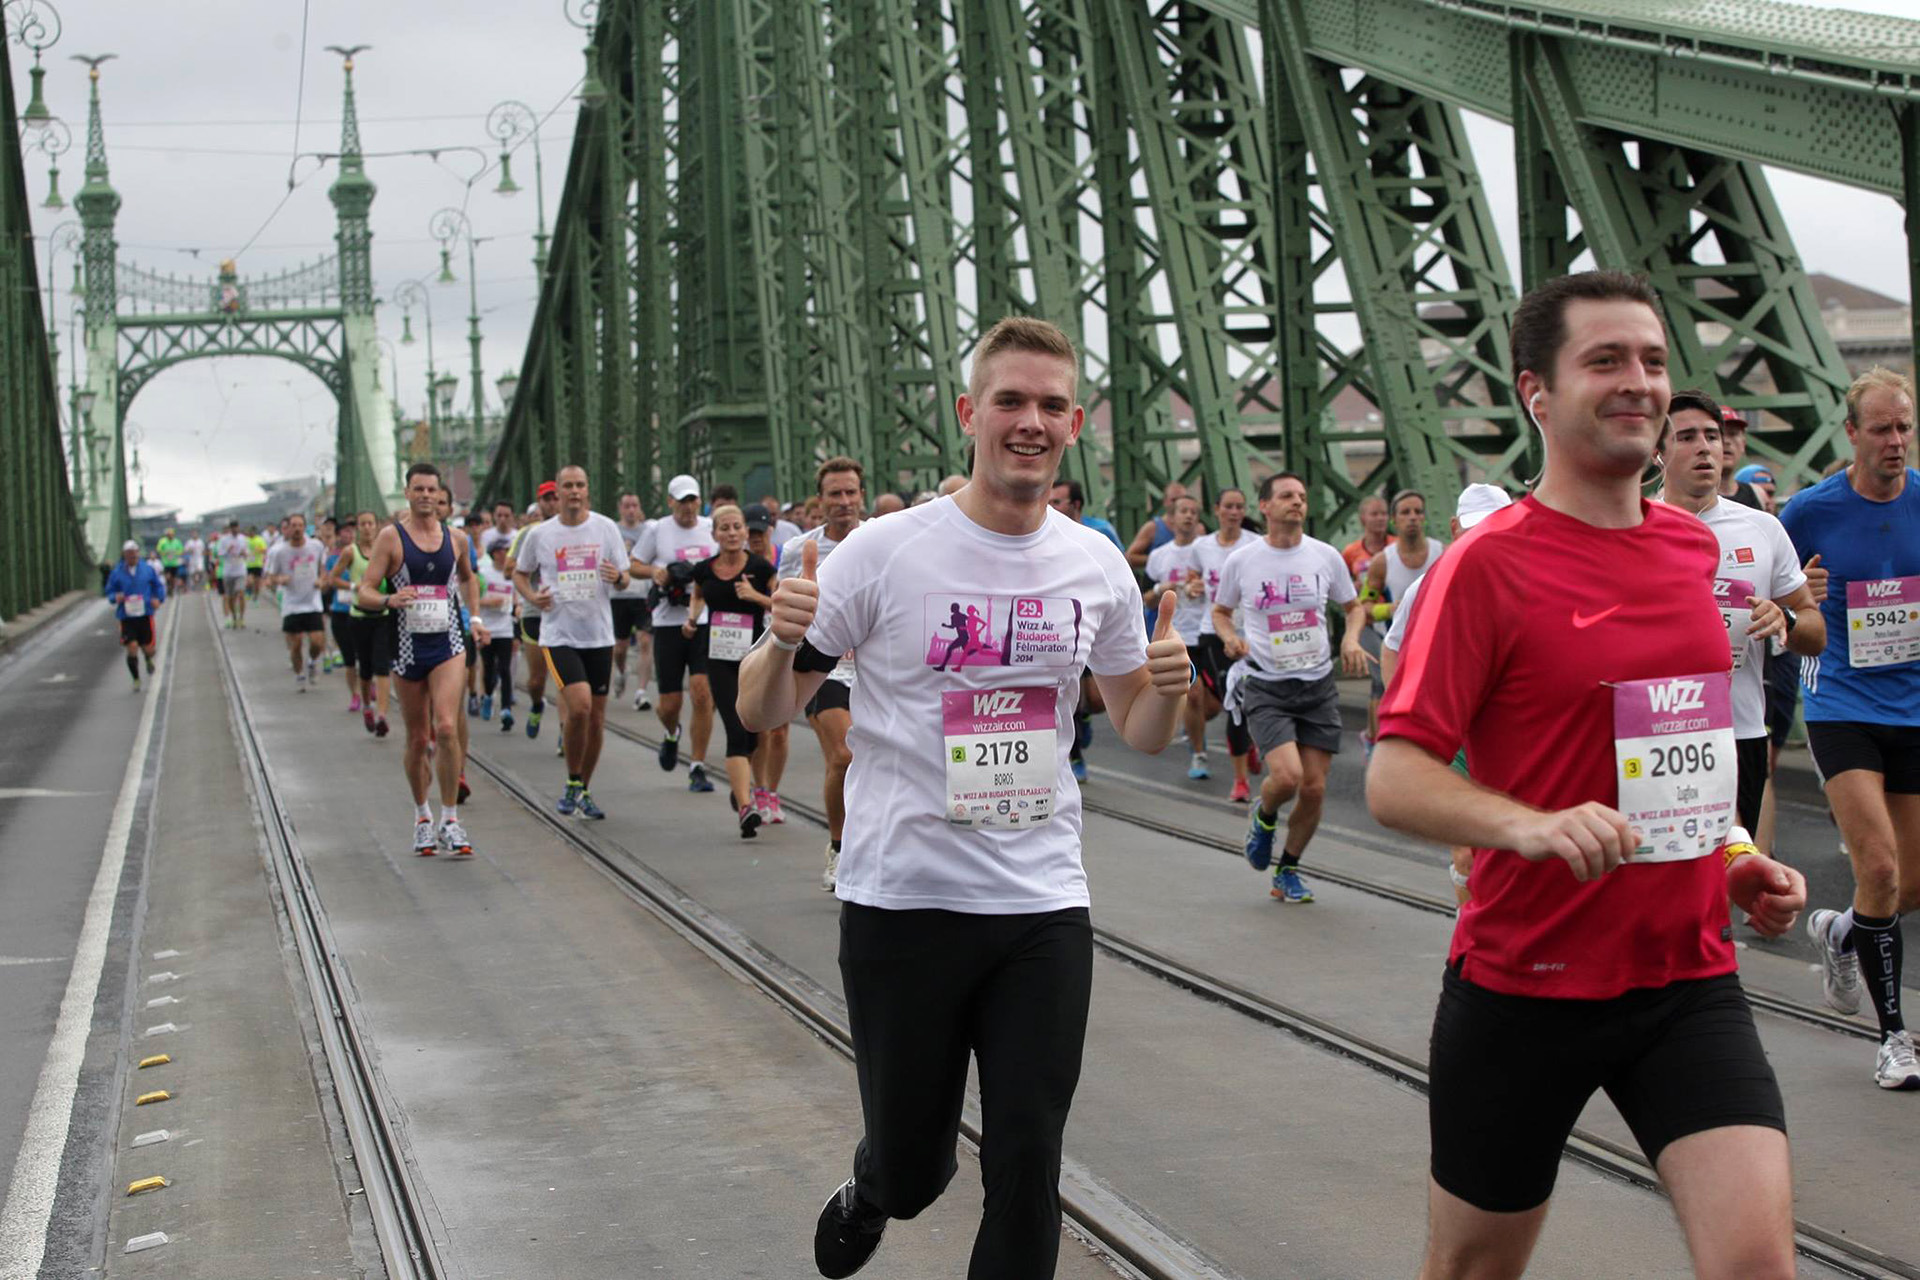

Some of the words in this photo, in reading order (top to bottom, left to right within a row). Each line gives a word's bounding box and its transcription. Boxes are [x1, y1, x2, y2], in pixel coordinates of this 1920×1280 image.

[1019, 601, 1042, 616] 29.
[1866, 609, 1907, 627] 5942
[1017, 620, 1039, 630] Wizz
[1042, 620, 1054, 631] Air
[1016, 631, 1060, 643] Budapest
[1283, 632, 1310, 643] 4045
[1015, 654, 1034, 663] 2014
[972, 721, 1026, 733] wizzair.com
[1651, 716, 1710, 734] wizzair.com
[955, 749, 962, 757] 2
[975, 740, 1029, 767] 2178
[1650, 742, 1715, 778] 2096
[1629, 762, 1637, 774] 3
[994, 773, 1014, 786] BOROS
[963, 791, 978, 800] WIZZ
[978, 790, 989, 799] AIR
[989, 788, 1017, 799] BUDAPEST
